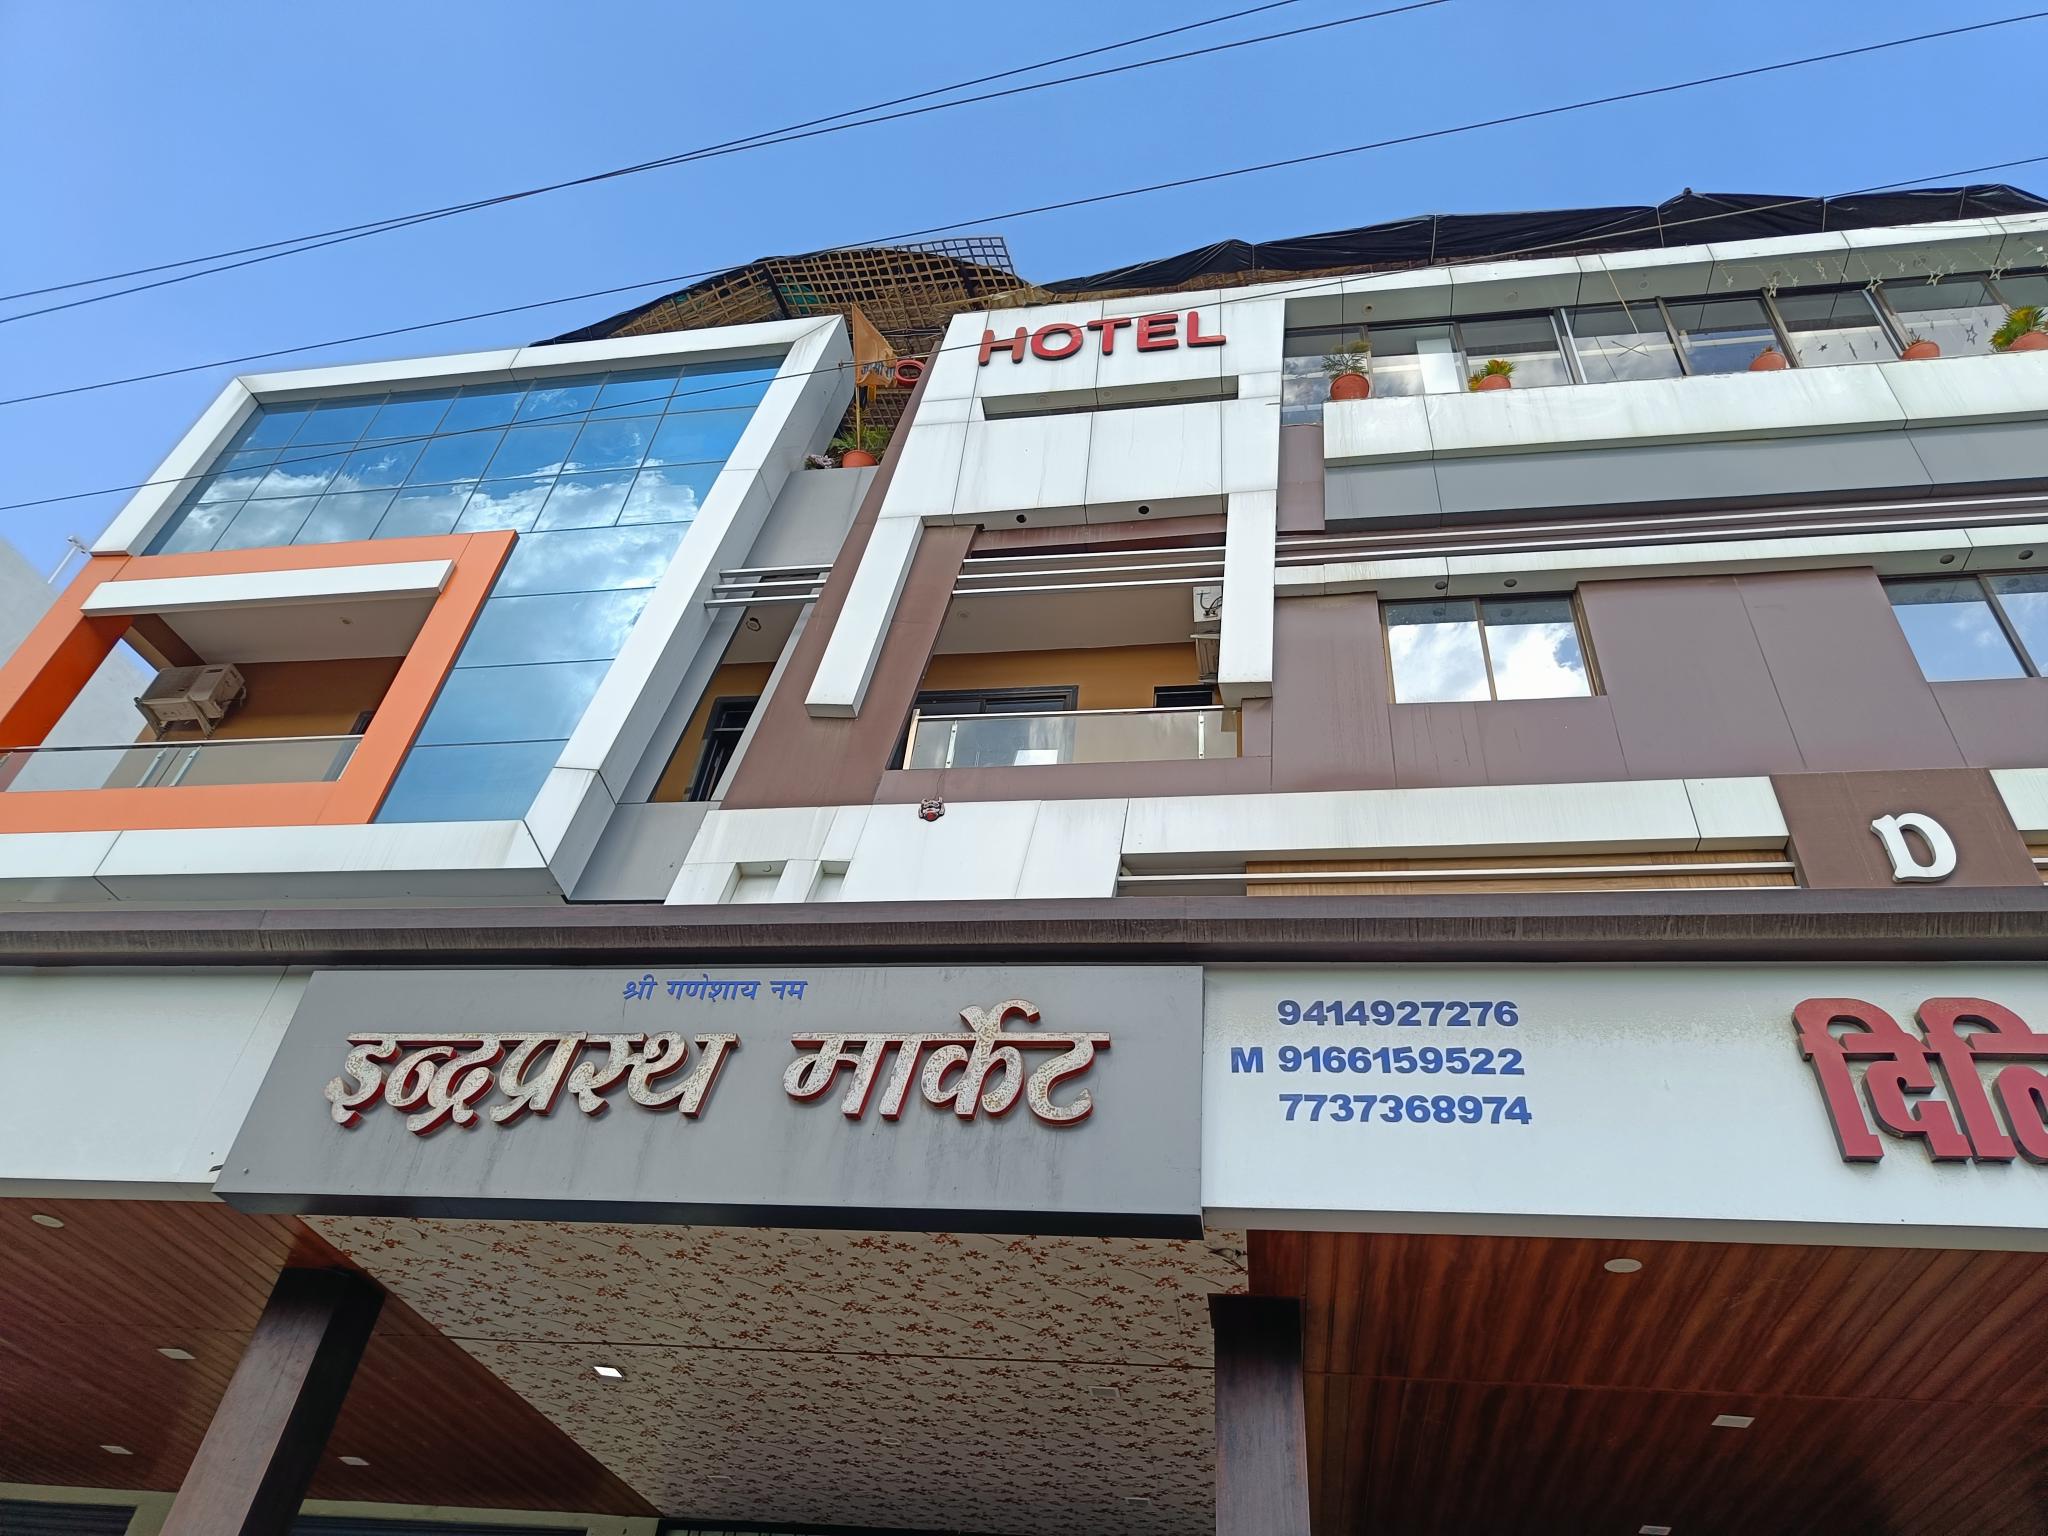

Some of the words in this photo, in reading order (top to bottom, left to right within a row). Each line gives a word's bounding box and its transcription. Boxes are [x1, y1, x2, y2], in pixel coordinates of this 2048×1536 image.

[979, 311, 1226, 366] HOTEL
[1871, 812, 1957, 882] D
[623, 974, 658, 1001] श्री
[667, 973, 761, 1003] गणेशाय
[770, 980, 808, 1001] नम
[1277, 1000, 1519, 1027] 9414927276
[323, 1031, 742, 1136] इन्द्रप्रस्थ
[783, 998, 1111, 1127] मार्केट
[1230, 1046, 1264, 1073] M
[1278, 1046, 1525, 1075] 9166159522
[1279, 1093, 1532, 1125] 7737368974
